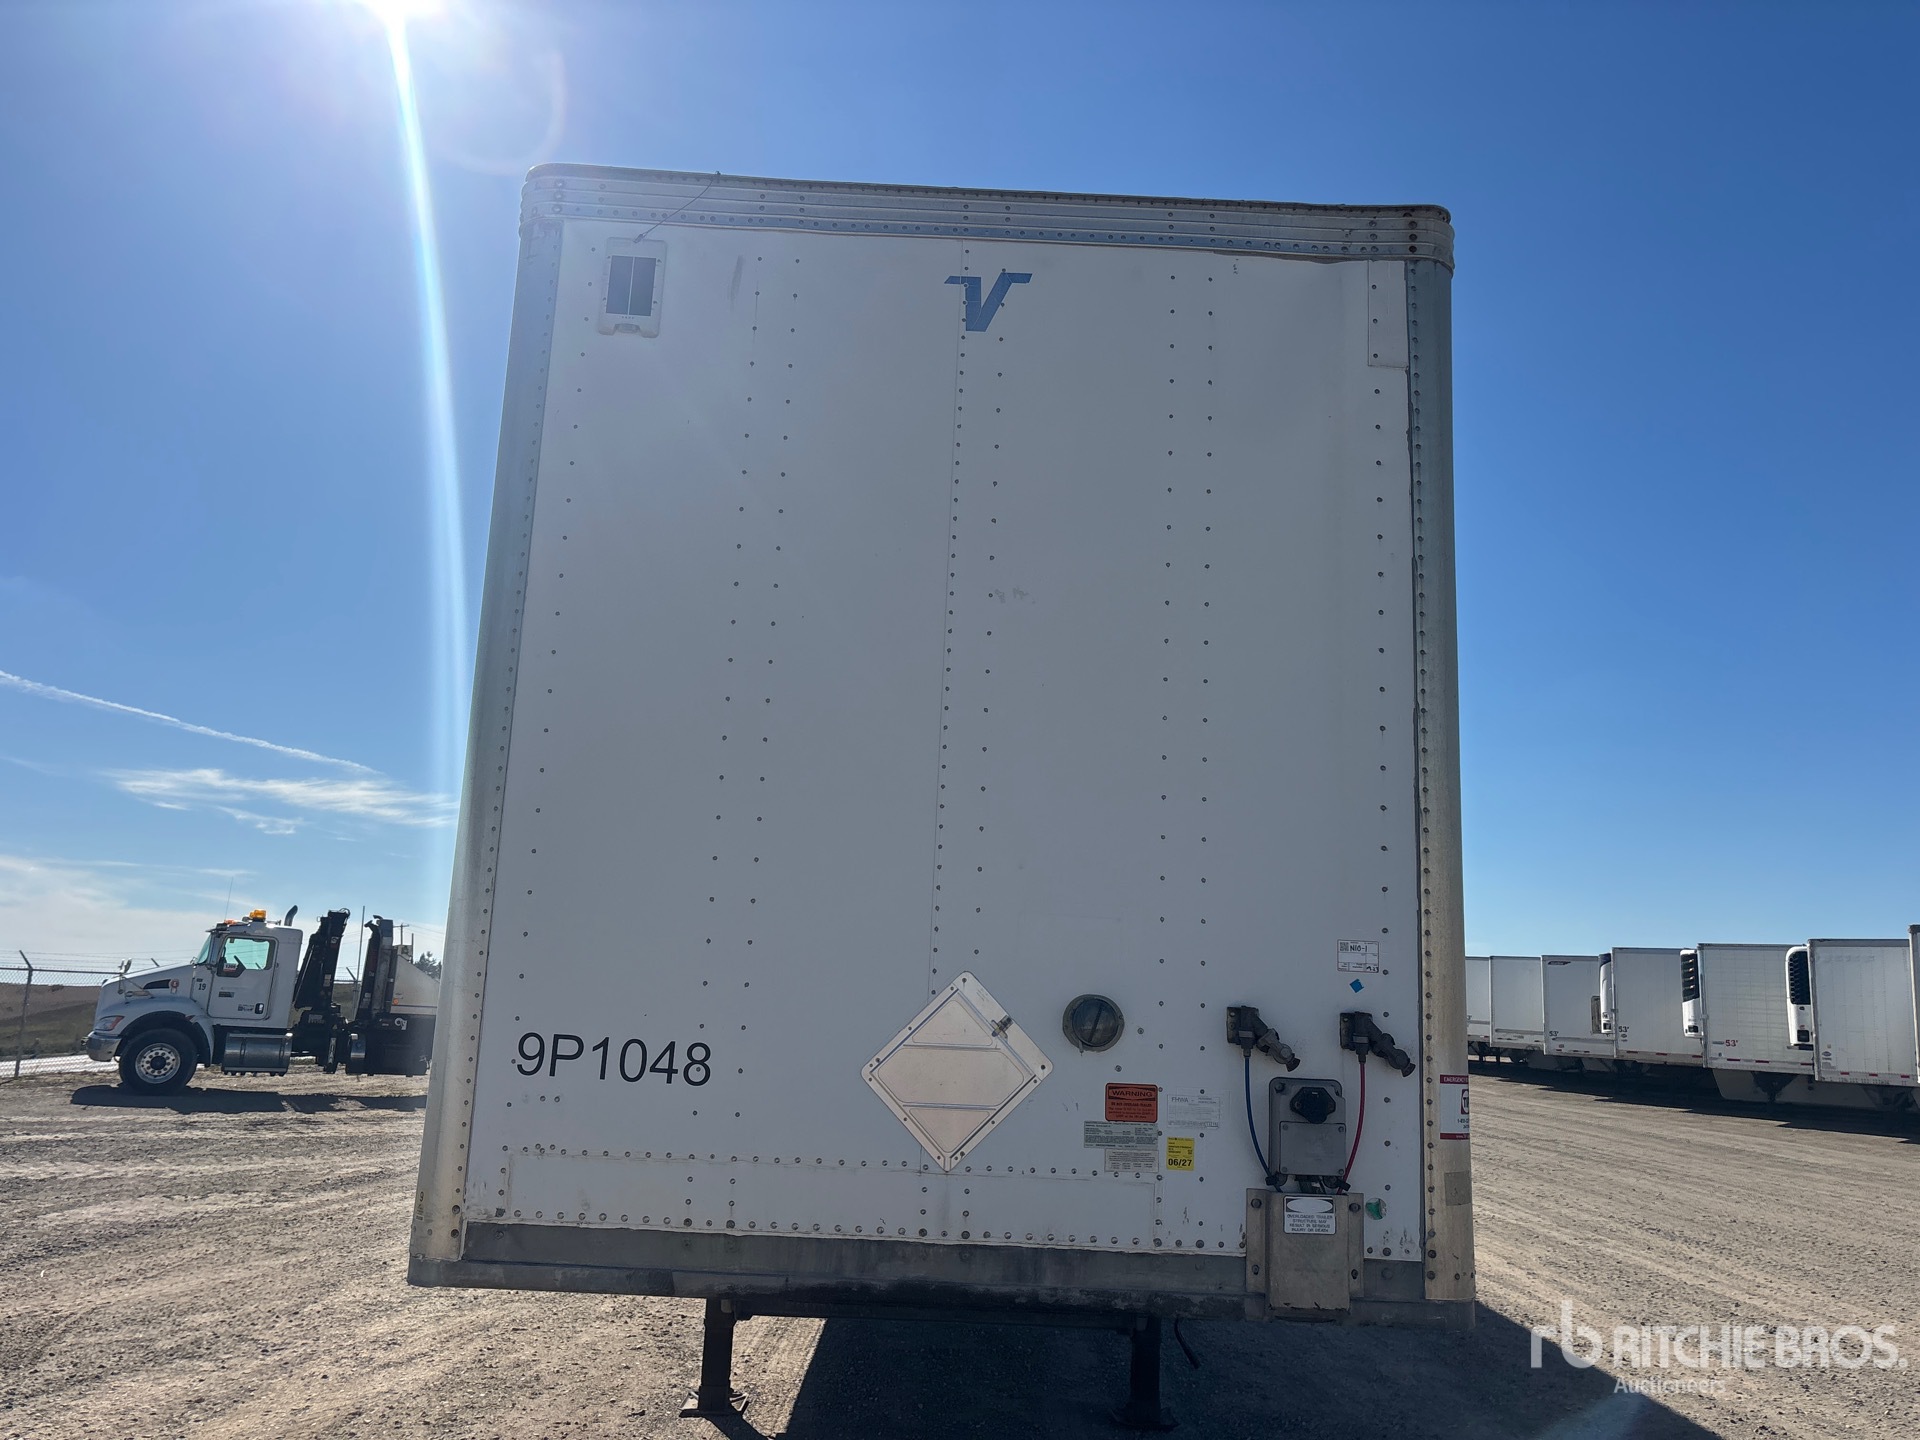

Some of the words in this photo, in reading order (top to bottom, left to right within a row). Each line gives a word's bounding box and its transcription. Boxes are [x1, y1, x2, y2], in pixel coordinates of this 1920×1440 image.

[198, 983, 207, 991] 19
[1725, 1039, 1738, 1047] 53'
[516, 1031, 711, 1087] 9P1048
[1112, 1090, 1153, 1098] WARNING
[1168, 1158, 1192, 1167] 06/27
